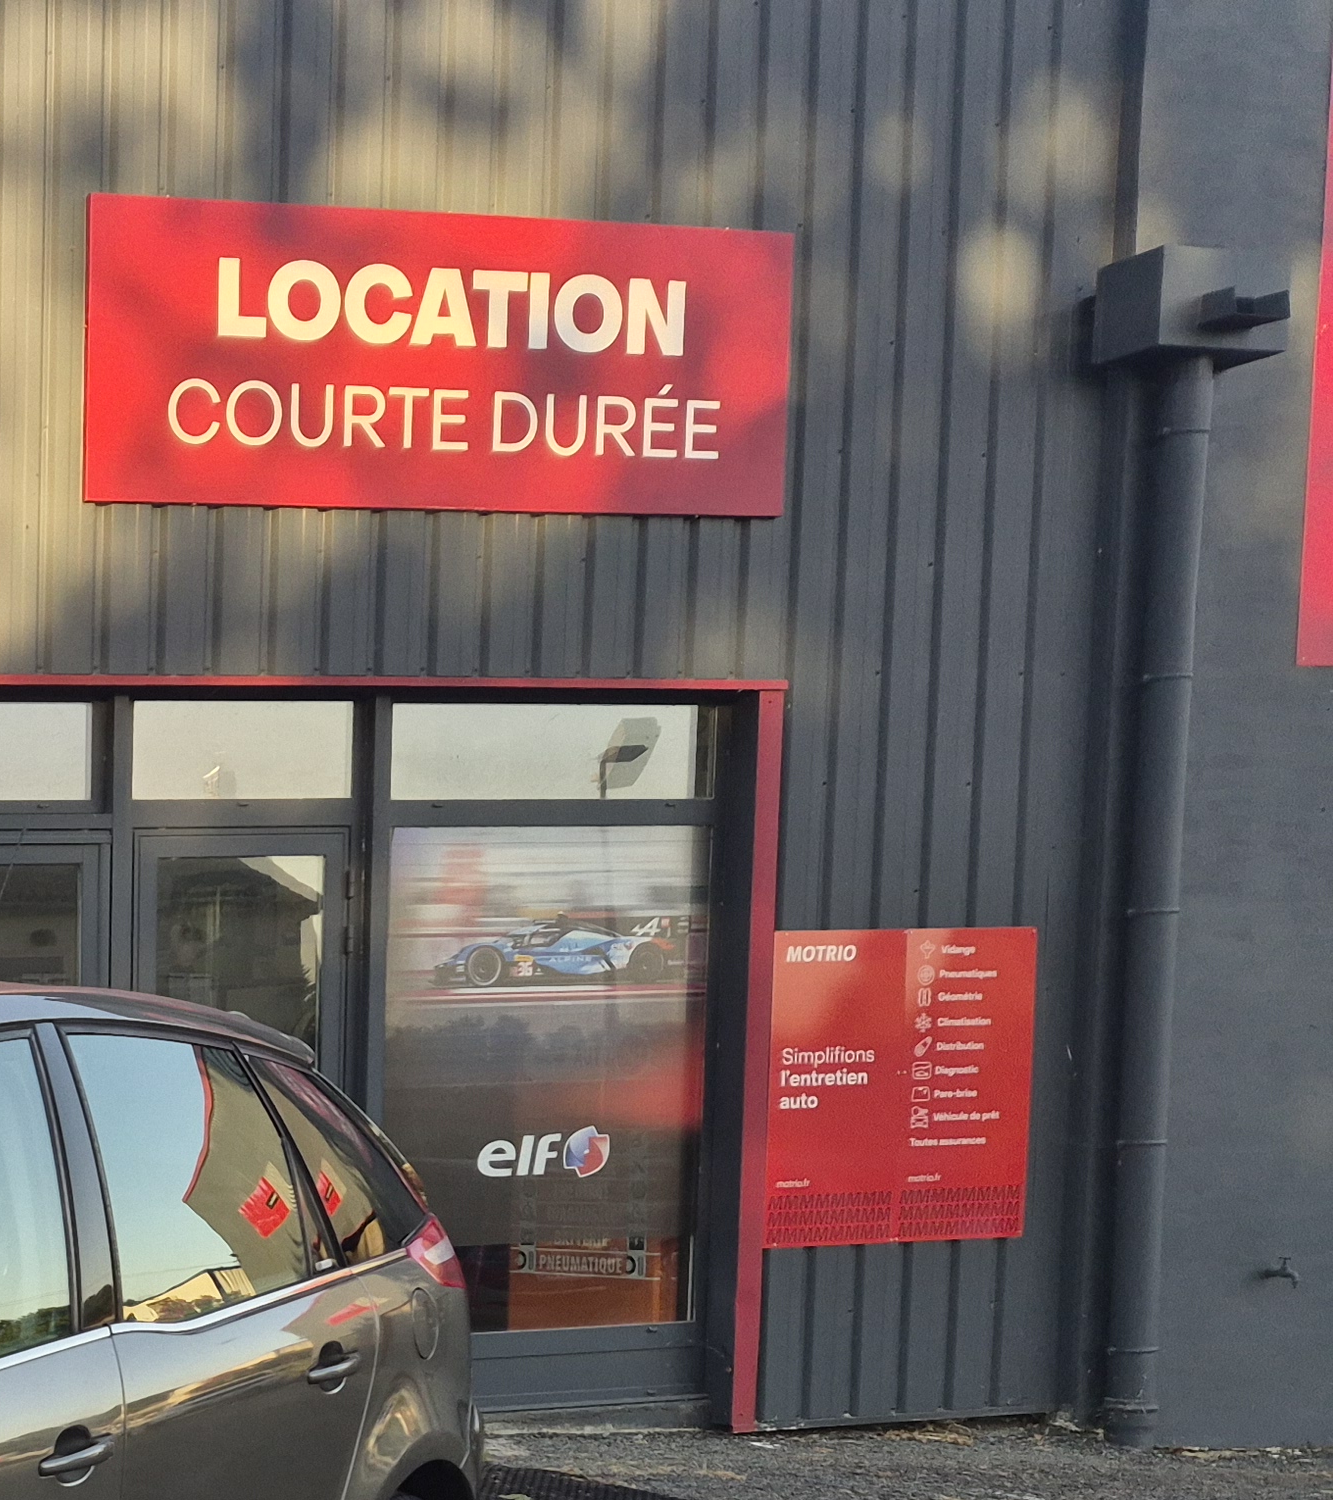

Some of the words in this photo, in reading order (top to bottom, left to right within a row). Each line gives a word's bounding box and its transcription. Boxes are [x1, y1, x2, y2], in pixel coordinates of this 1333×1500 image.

[217, 257, 686, 356] LOCATION
[168, 378, 469, 451] COURTE
[491, 384, 721, 460] DURÉE
[786, 945, 857, 963] MOTRIO
[941, 945, 976, 956] Vidange
[939, 968, 998, 979] Pneumatiques
[936, 1041, 984, 1051] Distribution
[782, 1047, 875, 1067] Simplifions
[780, 1069, 869, 1087] l'entretien
[934, 1065, 979, 1077] Diagnostic
[779, 1093, 819, 1109] auto
[933, 1088, 978, 1098] Pare-brise
[477, 1133, 562, 1178] elf
[539, 1254, 623, 1274] PNEUMATIQUE
